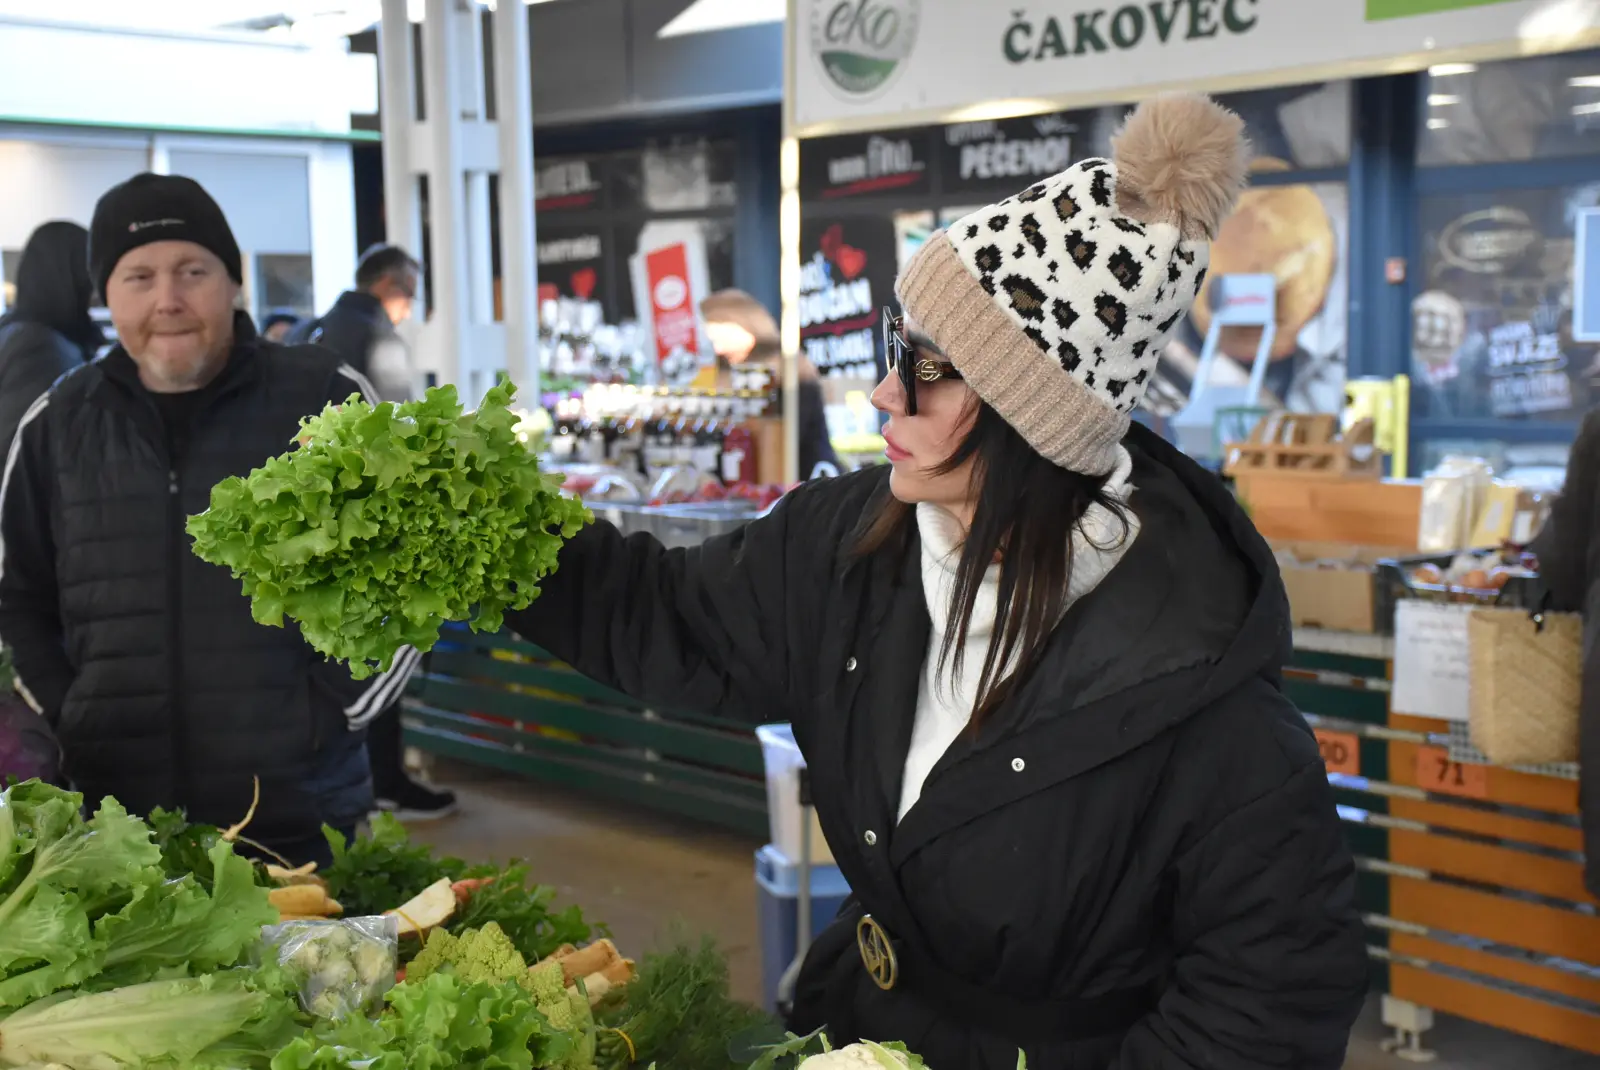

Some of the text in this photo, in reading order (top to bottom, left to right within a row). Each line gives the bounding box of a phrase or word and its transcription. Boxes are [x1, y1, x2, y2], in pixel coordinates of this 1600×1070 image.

[824, 0, 901, 51] eko
[1002, 0, 1259, 64] ČAKOVEC
[1436, 756, 1464, 786] 71
